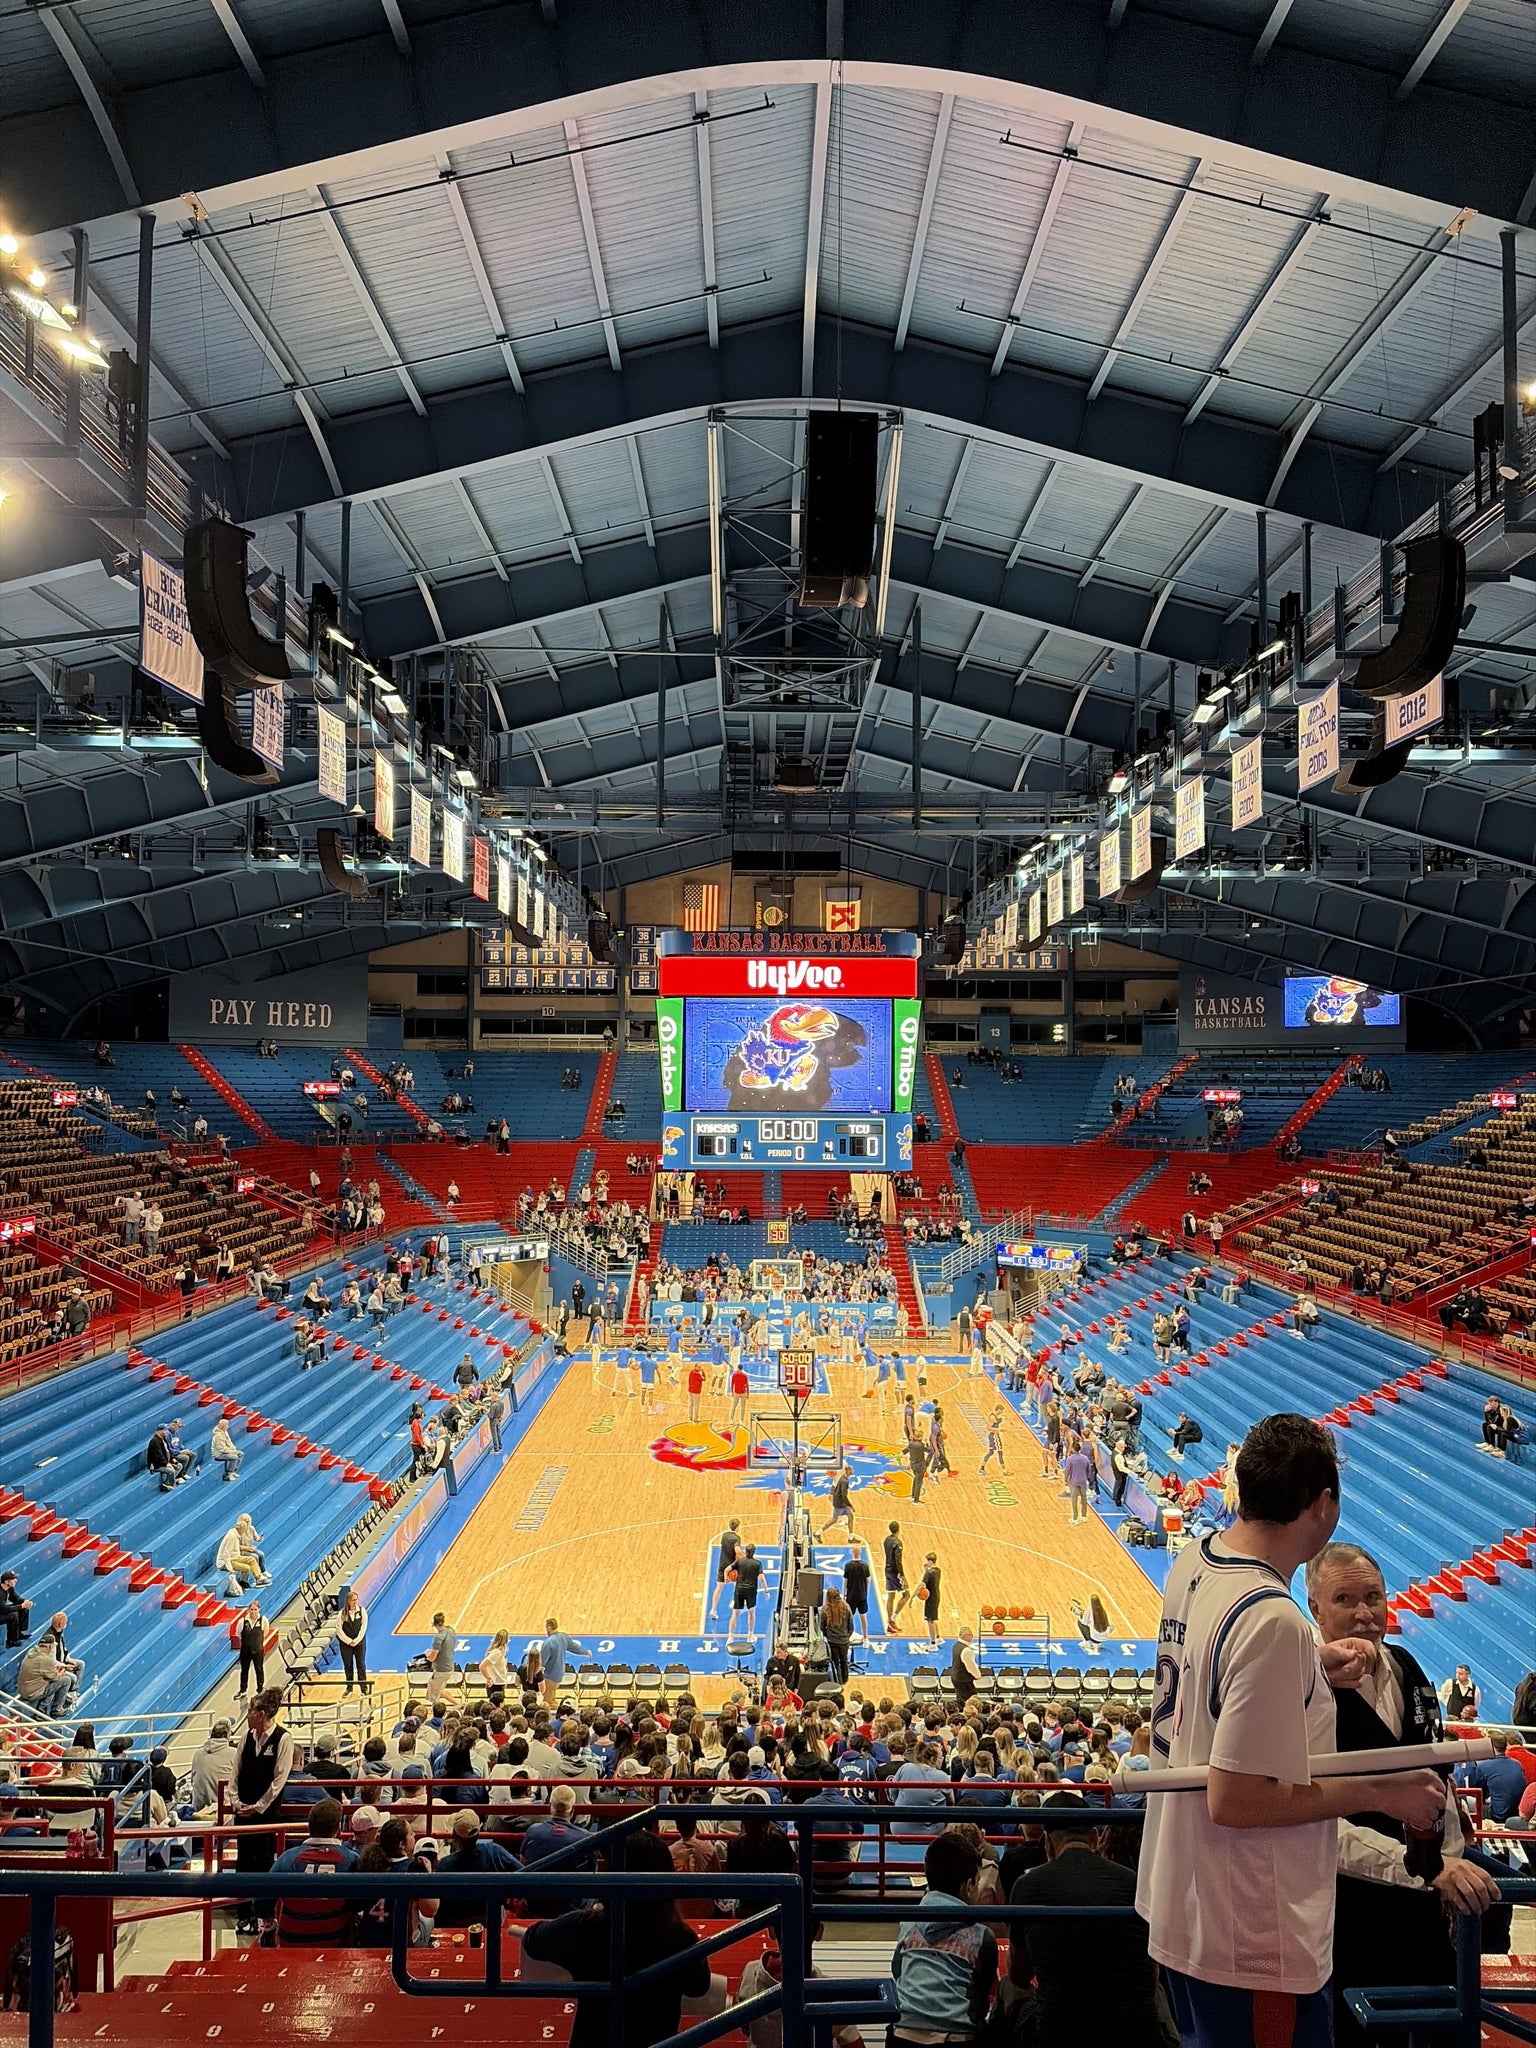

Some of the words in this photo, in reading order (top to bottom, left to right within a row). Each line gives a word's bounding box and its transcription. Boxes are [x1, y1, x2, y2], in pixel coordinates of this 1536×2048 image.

[160, 570, 176, 594] BIG
[146, 586, 192, 633] CHAMPIO
[167, 628, 183, 648] 2023
[1400, 693, 1426, 728] 2012
[1308, 749, 1328, 777] 2008
[692, 932, 764, 952] KANSAS
[769, 932, 886, 952] BASKETBALL
[1016, 956, 1022, 964] 4
[1041, 957, 1050, 965] 10
[489, 973, 500, 982] 23
[571, 975, 577, 983] 4
[596, 975, 607, 983] 45
[639, 975, 650, 984] 22
[543, 1007, 554, 1016] 10
[1194, 997, 1265, 1015] KANSAS
[209, 999, 256, 1025] PAY
[267, 1001, 332, 1028] HEED
[1194, 1016, 1267, 1029] BASKETBALL
[990, 1028, 1000, 1037] 13
[765, 1049, 791, 1066] KU
[661, 1045, 677, 1095] fnbo
[899, 1047, 915, 1097] fnbo
[697, 1123, 738, 1134] KANSAS
[762, 1120, 815, 1140] 60:00
[849, 1124, 870, 1134] TCU
[715, 1136, 727, 1156] 0
[743, 1140, 752, 1151] 4
[825, 1140, 833, 1151] 4
[866, 1136, 879, 1156] 0
[768, 1149, 792, 1157] PERIOD
[795, 1145, 805, 1160] 0
[781, 1353, 811, 1364] 60:00
[785, 1364, 808, 1384] 30
[454, 1954, 465, 1963] 5
[277, 1967, 289, 1977] 7
[430, 1968, 442, 1977] 5
[161, 2002, 174, 2013] 7
[363, 2002, 376, 2013] 5
[464, 2003, 476, 2013] 4
[564, 2002, 576, 2013] 3
[95, 2023, 110, 2036] 7
[431, 2026, 445, 2038] 4
[542, 2026, 555, 2038] 3
